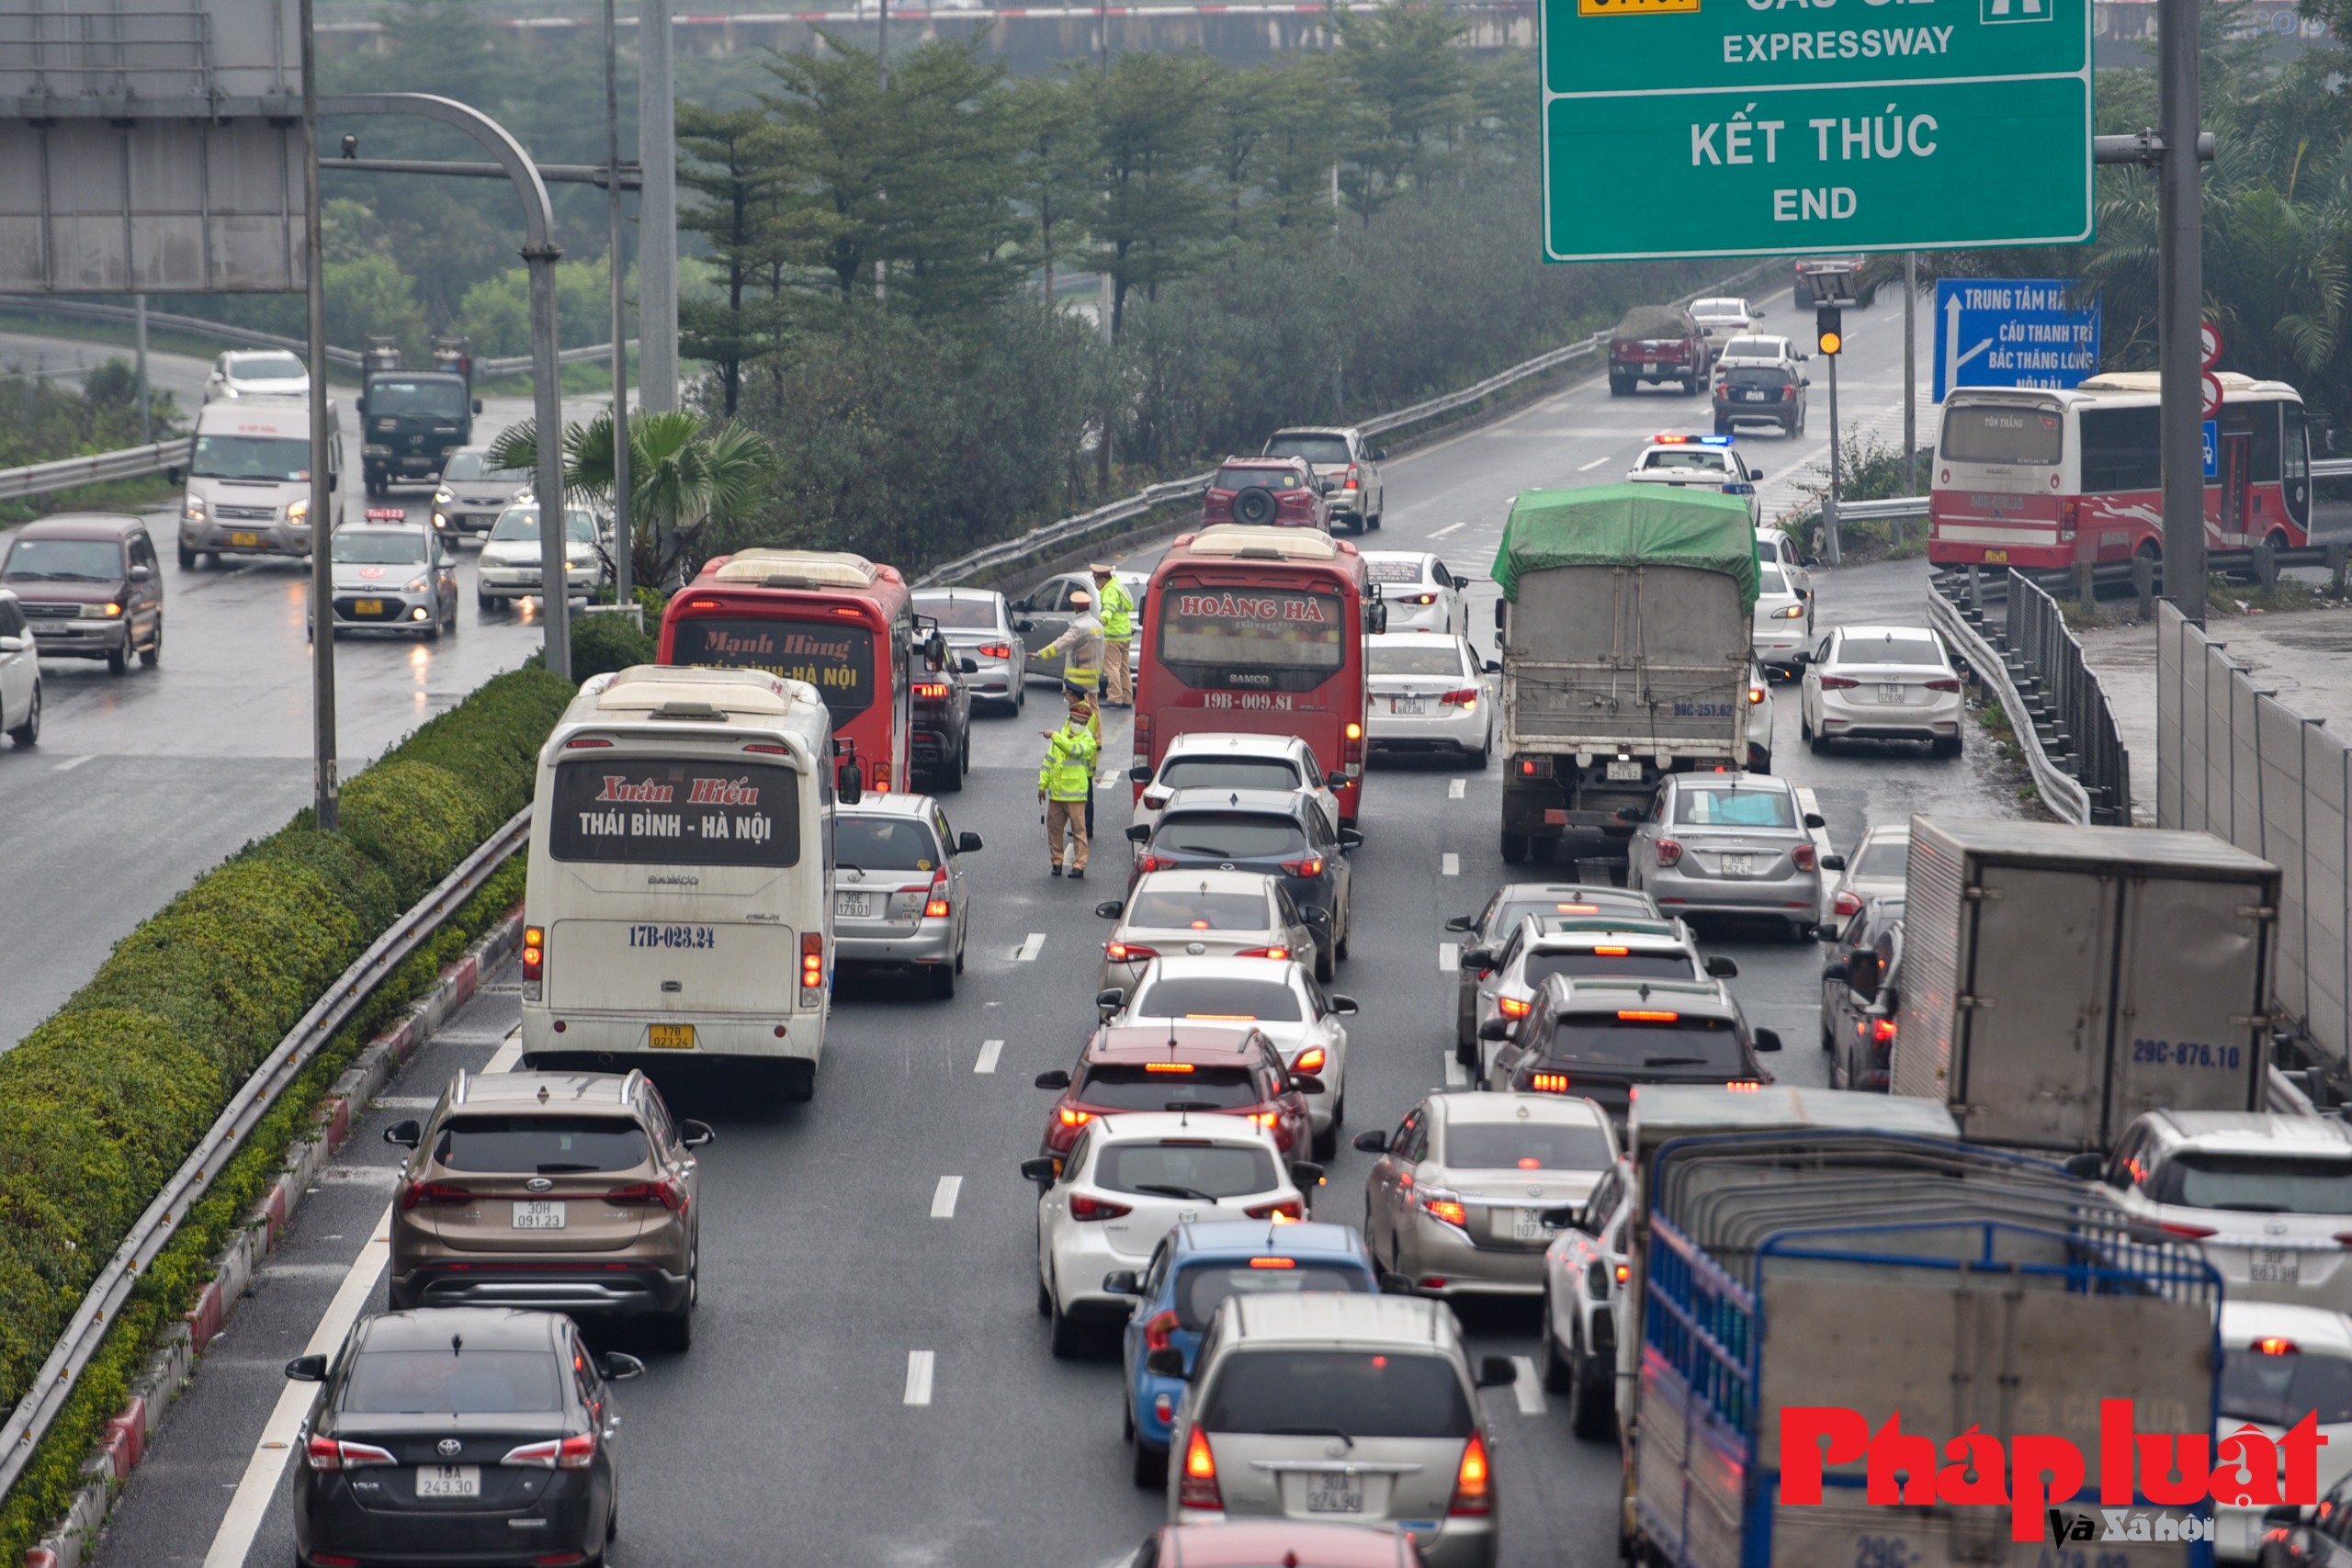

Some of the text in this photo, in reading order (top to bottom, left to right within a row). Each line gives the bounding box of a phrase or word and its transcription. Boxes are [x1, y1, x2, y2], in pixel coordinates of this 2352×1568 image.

[1723, 26, 1954, 62] EXPRESSWAY
[1690, 103, 1938, 166] KẾT THÚC
[1773, 186, 1857, 221] END
[1965, 288, 2012, 310] TRUNG
[2015, 286, 2044, 310] TÂM
[1999, 319, 2024, 342] CẦU
[2028, 324, 2070, 343] THANH
[1989, 344, 2014, 368] BẮC
[2017, 348, 2058, 369] THĂNG
[1181, 593, 1324, 622] HOÀNG HÀ
[705, 631, 851, 661] Mạnh Hùng
[824, 664, 856, 690] NỘI
[1229, 674, 1269, 684] SAMCO
[1674, 704, 1732, 716] 89C-251.62
[596, 775, 758, 805] Xuân Hiếu
[580, 808, 625, 835] THÁI
[631, 808, 680, 837] BÌNH
[702, 810, 729, 839] HÀ
[736, 812, 771, 844] NỘI
[648, 874, 699, 886] SAMCO
[839, 904, 869, 915] 179.01
[845, 892, 864, 904] 30E
[628, 925, 715, 949] 17B-023.24
[653, 1037, 688, 1047] 023.24
[662, 1027, 681, 1036] 17B
[2133, 1039, 2239, 1068] 29C-876.10
[527, 1202, 550, 1213] 30H
[1523, 1210, 1541, 1223] 30
[518, 1216, 560, 1226] 091.23
[424, 1481, 472, 1494] 243.30
